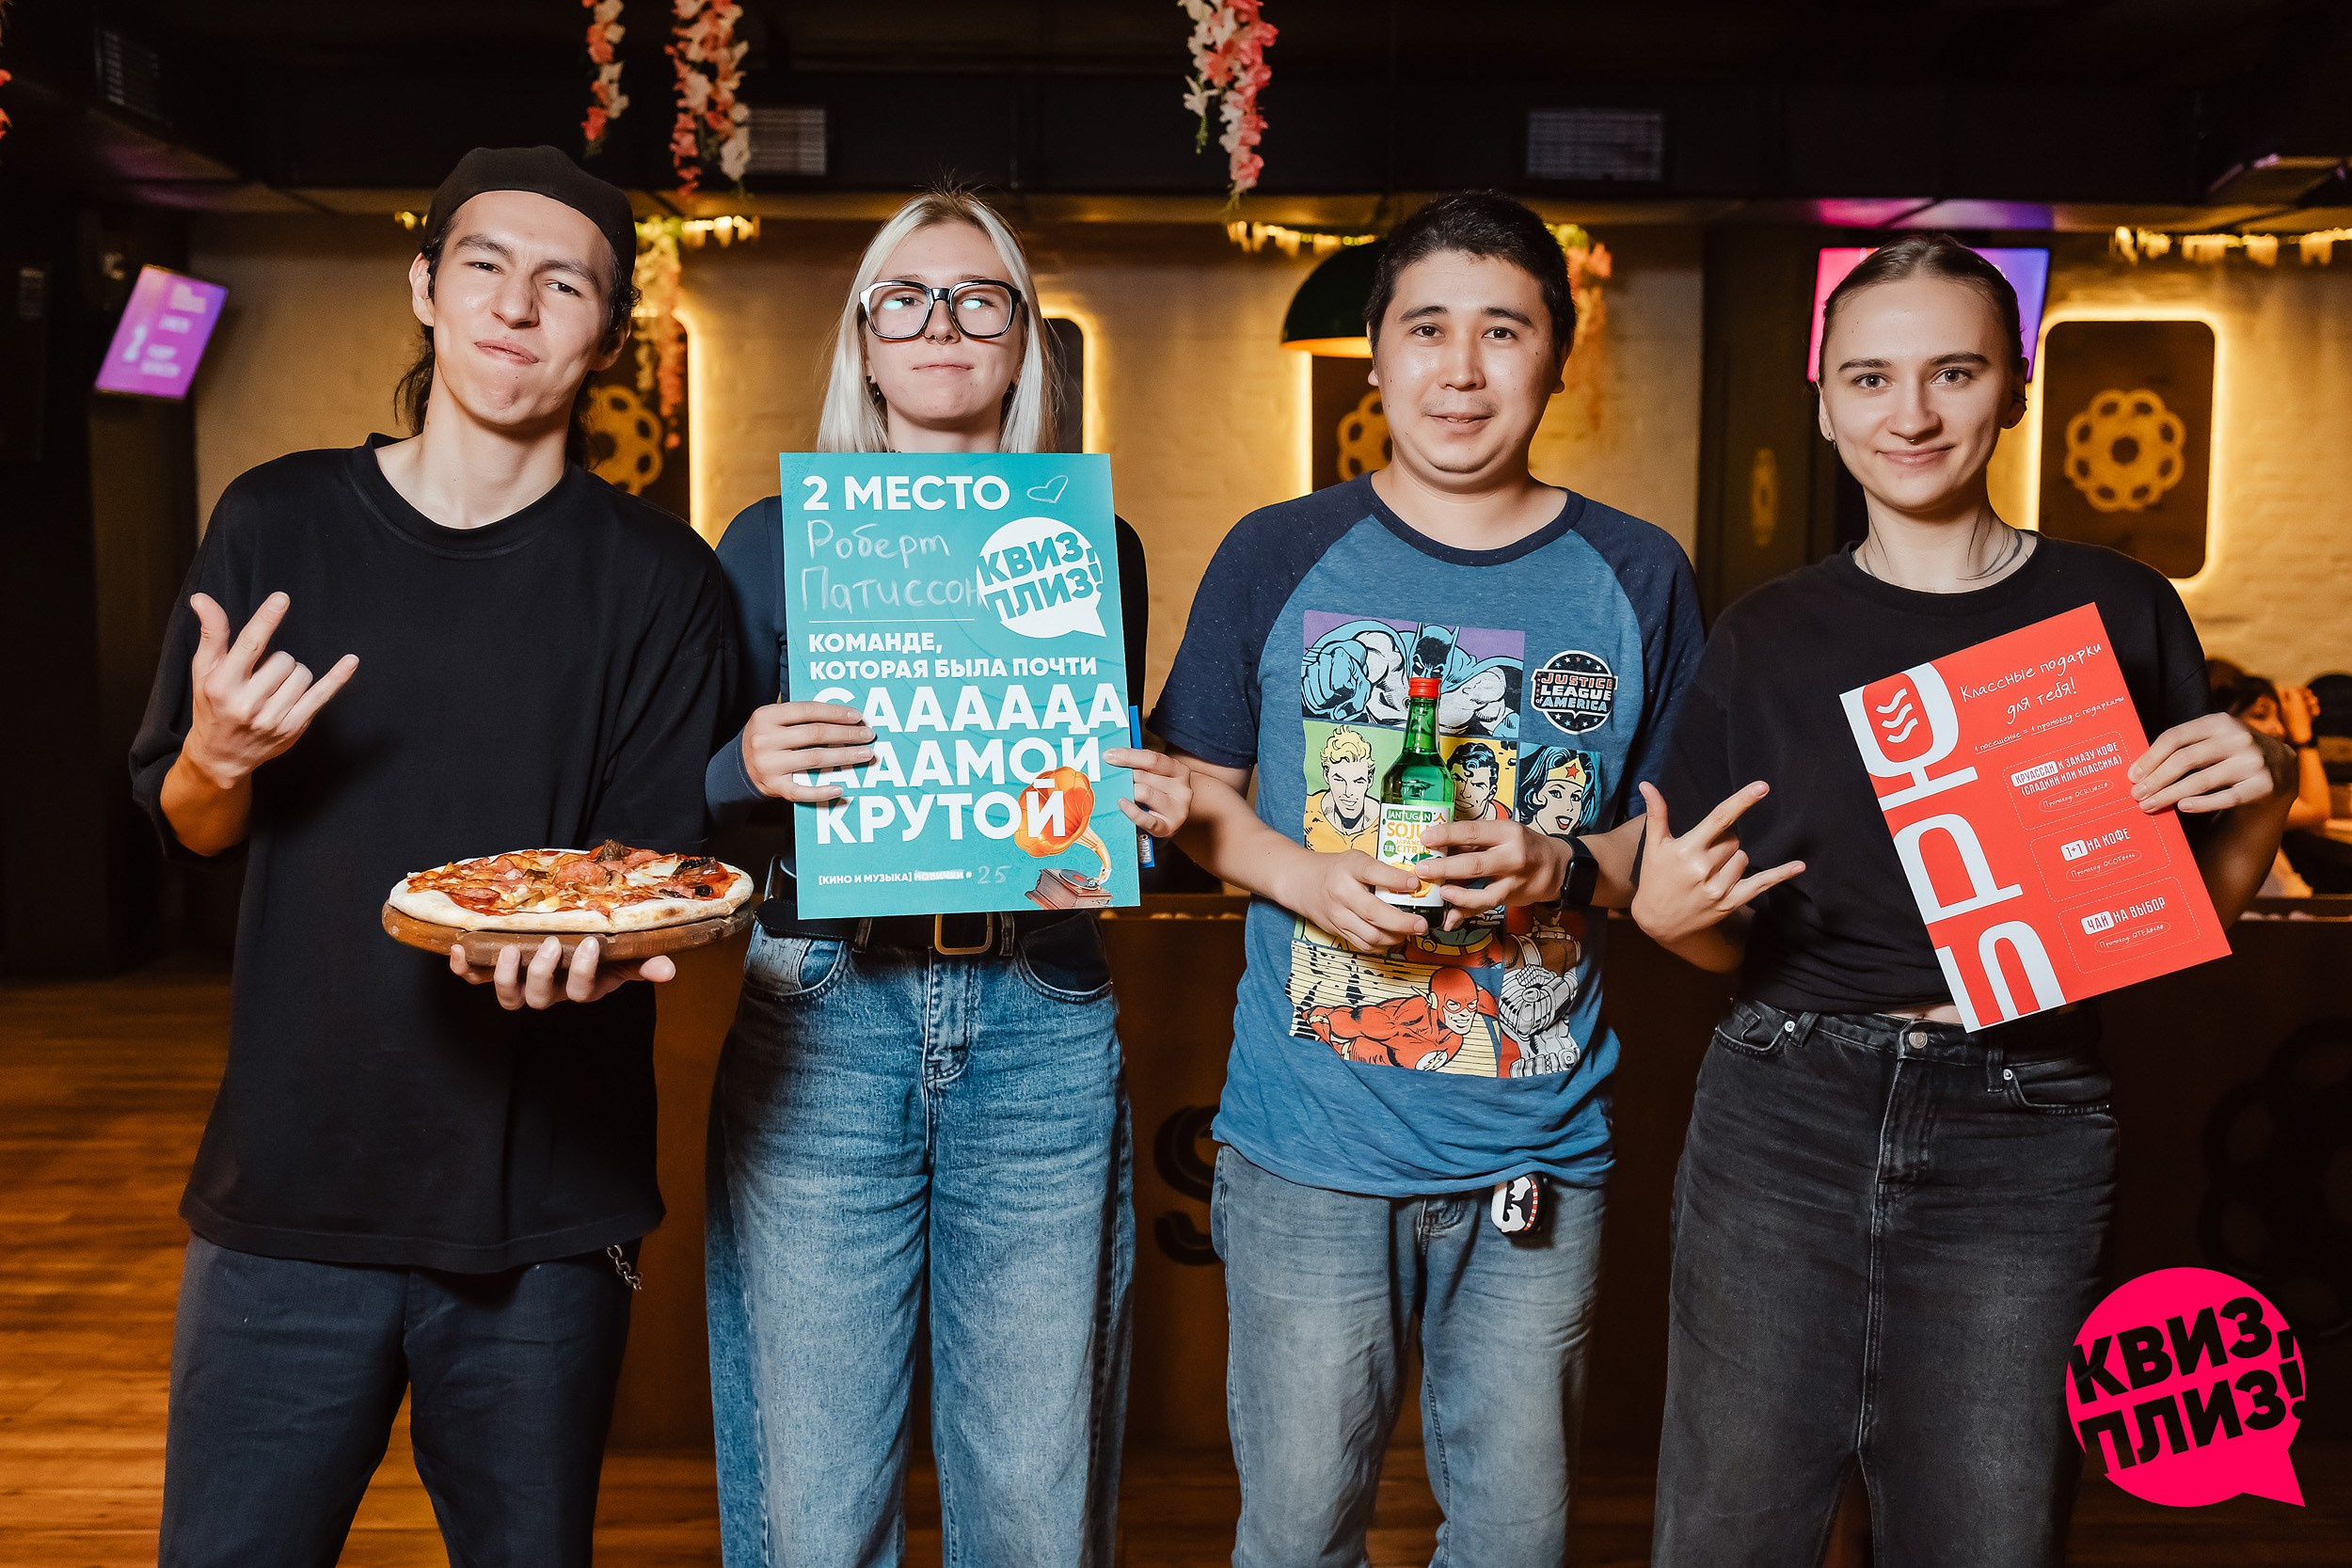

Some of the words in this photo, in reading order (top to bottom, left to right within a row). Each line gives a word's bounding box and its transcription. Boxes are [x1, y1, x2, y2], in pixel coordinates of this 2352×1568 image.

[802, 475, 830, 511] 2
[844, 474, 1010, 511] МЕСТО
[807, 518, 950, 569] Роберт
[978, 531, 1097, 587] КВИЗ,
[801, 565, 983, 614] Патиссон
[983, 563, 1103, 622] ПЛИЗ!
[809, 632, 943, 655] КОМАНДЕ,
[810, 659, 929, 680] КОТОРАЯ
[935, 657, 1008, 678] БЫЛА
[1013, 657, 1097, 676] ПОЧТИ
[1541, 673, 1613, 689] JUSTICE
[1960, 667, 2036, 703] Классные
[2040, 643, 2102, 676] подарки
[1540, 685, 1613, 701] LEAGUE
[1541, 696, 1608, 712] AMERICA
[2007, 696, 2031, 724] для
[2037, 676, 2077, 705] тебя!
[1979, 733, 2022, 751] посещение
[2037, 715, 2074, 732] промокод
[2082, 696, 2124, 717] подарками
[2015, 764, 2056, 784] КРУАССАН
[2058, 761, 2065, 769] К
[2065, 750, 2095, 768] ЗАКАЗУ
[2096, 742, 2119, 757] КОФЕ
[2077, 754, 2122, 778] КЛАССИКА)
[816, 779, 1066, 845] КРУТОЙ
[1397, 845, 1431, 855] CITRUS
[2065, 844, 2084, 858] 1+1
[2086, 838, 2102, 851] НА
[2102, 828, 2130, 847] КОФЕ
[818, 875, 852, 885] [КИНО
[854, 875, 862, 883] И
[864, 872, 913, 883] МУЗЫКА]
[977, 865, 1011, 884] 25
[2087, 913, 2109, 930] ЧАЙ
[2113, 909, 2129, 924] НА
[2129, 896, 2166, 919] ВЫБОР
